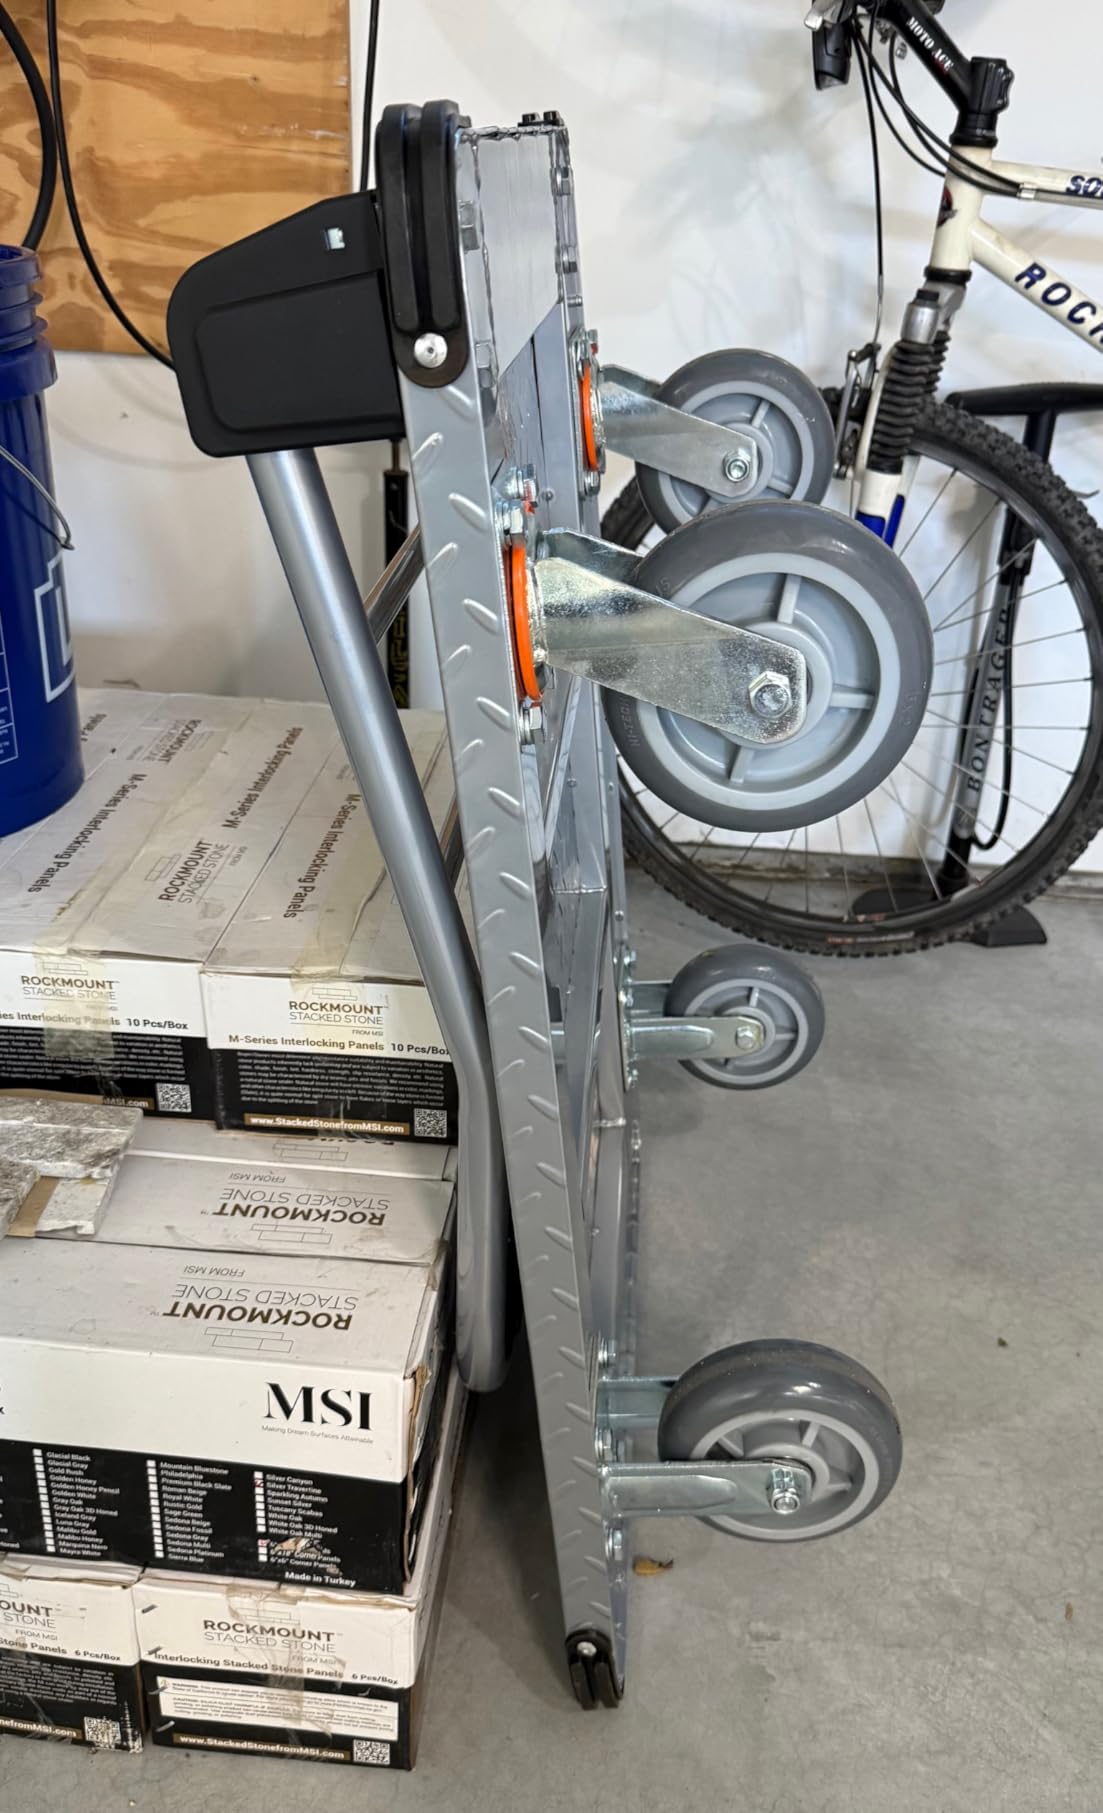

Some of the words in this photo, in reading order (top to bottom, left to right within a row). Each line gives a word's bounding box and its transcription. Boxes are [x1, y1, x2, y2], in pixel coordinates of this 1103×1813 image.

[906, 16, 935, 49] MOTO
[932, 48, 954, 71] ACE
[1066, 175, 1103, 197] SO
[106, 774, 147, 807] M-Series
[222, 793, 259, 829] M-Series
[248, 744, 291, 793] Interlocking
[331, 794, 362, 829] M-Series
[55, 809, 116, 858] Interlocking
[298, 831, 344, 883] Interlocking
[28, 862, 69, 893] Panels
[159, 837, 213, 901] ROCKMOUNT
[178, 866, 211, 904] STACKED
[205, 843, 230, 868] STONE
[283, 886, 316, 918] Panels
[21, 976, 113, 989] ROCKMOUNT
[23, 987, 74, 997] STACKED
[77, 989, 116, 1000] STONE
[289, 1001, 383, 1015] ROCKMOUNT
[17, 1012, 80, 1025] Interlocking
[84, 1016, 120, 1025] Panels
[126, 1018, 140, 1027] 10
[142, 1019, 188, 1029] Pcs/Box
[289, 1012, 342, 1022] STACKED
[345, 1015, 383, 1025] STONE
[229, 1035, 277, 1045] M-Series
[282, 1037, 345, 1050] Interlocking
[349, 1041, 384, 1050] Panels
[391, 1043, 404, 1051] 10
[251, 1117, 404, 1133] www.StackedStonefromMSI.com
[253, 1173, 286, 1183] FROM
[220, 1188, 291, 1203] STONE
[296, 1194, 390, 1211] STACKED
[213, 1203, 386, 1226] ROCKMOUNT
[184, 1265, 206, 1274] MSI
[209, 1267, 245, 1277] FROM
[172, 1284, 250, 1302] STONE
[256, 1290, 359, 1310] STACKED
[163, 1301, 352, 1330] ROCKMOUNT
[264, 1382, 372, 1430] MSI
[262, 1425, 285, 1434] Making
[311, 1431, 339, 1439] Surfaces
[72, 1462, 88, 1470] Gray
[161, 1462, 193, 1471] Mountain
[161, 1470, 203, 1479] Philadelphia
[75, 1477, 96, 1485] Honey
[76, 1484, 97, 1493] Honey
[81, 1514, 96, 1522] Gray
[166, 1524, 191, 1532] Sedona
[193, 1534, 208, 1542] Gray
[168, 1546, 192, 1554] Sedona
[285, 1572, 311, 1581] Made
[325, 1576, 356, 1586] Turkey
[3, 1612, 56, 1628] STONE
[203, 1620, 334, 1642] ROCKMOUNT
[204, 1632, 277, 1647] STACKED
[281, 1639, 335, 1653] STONE
[31, 1642, 67, 1655] Panels
[83, 1651, 120, 1661] Pcs/Box
[154, 1653, 220, 1666] Interlocking
[223, 1659, 268, 1670] Stacked
[272, 1664, 304, 1674] Stone
[307, 1667, 344, 1678] Panels
[360, 1674, 398, 1685] Pcs/Box
[180, 1736, 345, 1759] www.StackedStonefromMSI.com
